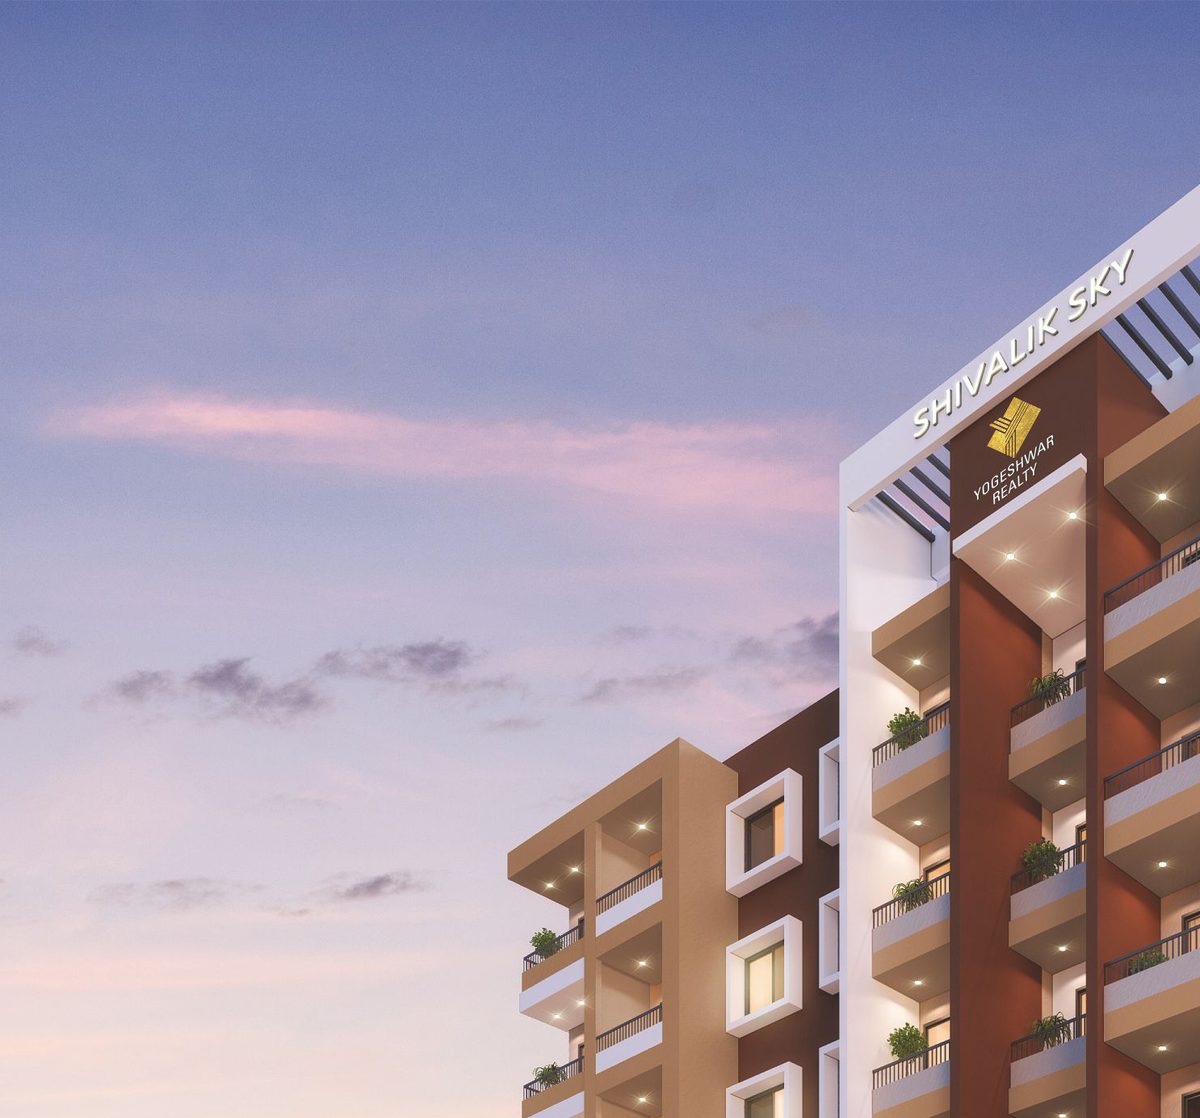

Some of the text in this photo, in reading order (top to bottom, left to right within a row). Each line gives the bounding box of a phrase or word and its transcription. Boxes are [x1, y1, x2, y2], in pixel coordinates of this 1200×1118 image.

[913, 249, 1134, 439] SHIVALIK SKY
[973, 435, 1054, 500] YOGESHWAR
[992, 462, 1037, 504] REALTY
